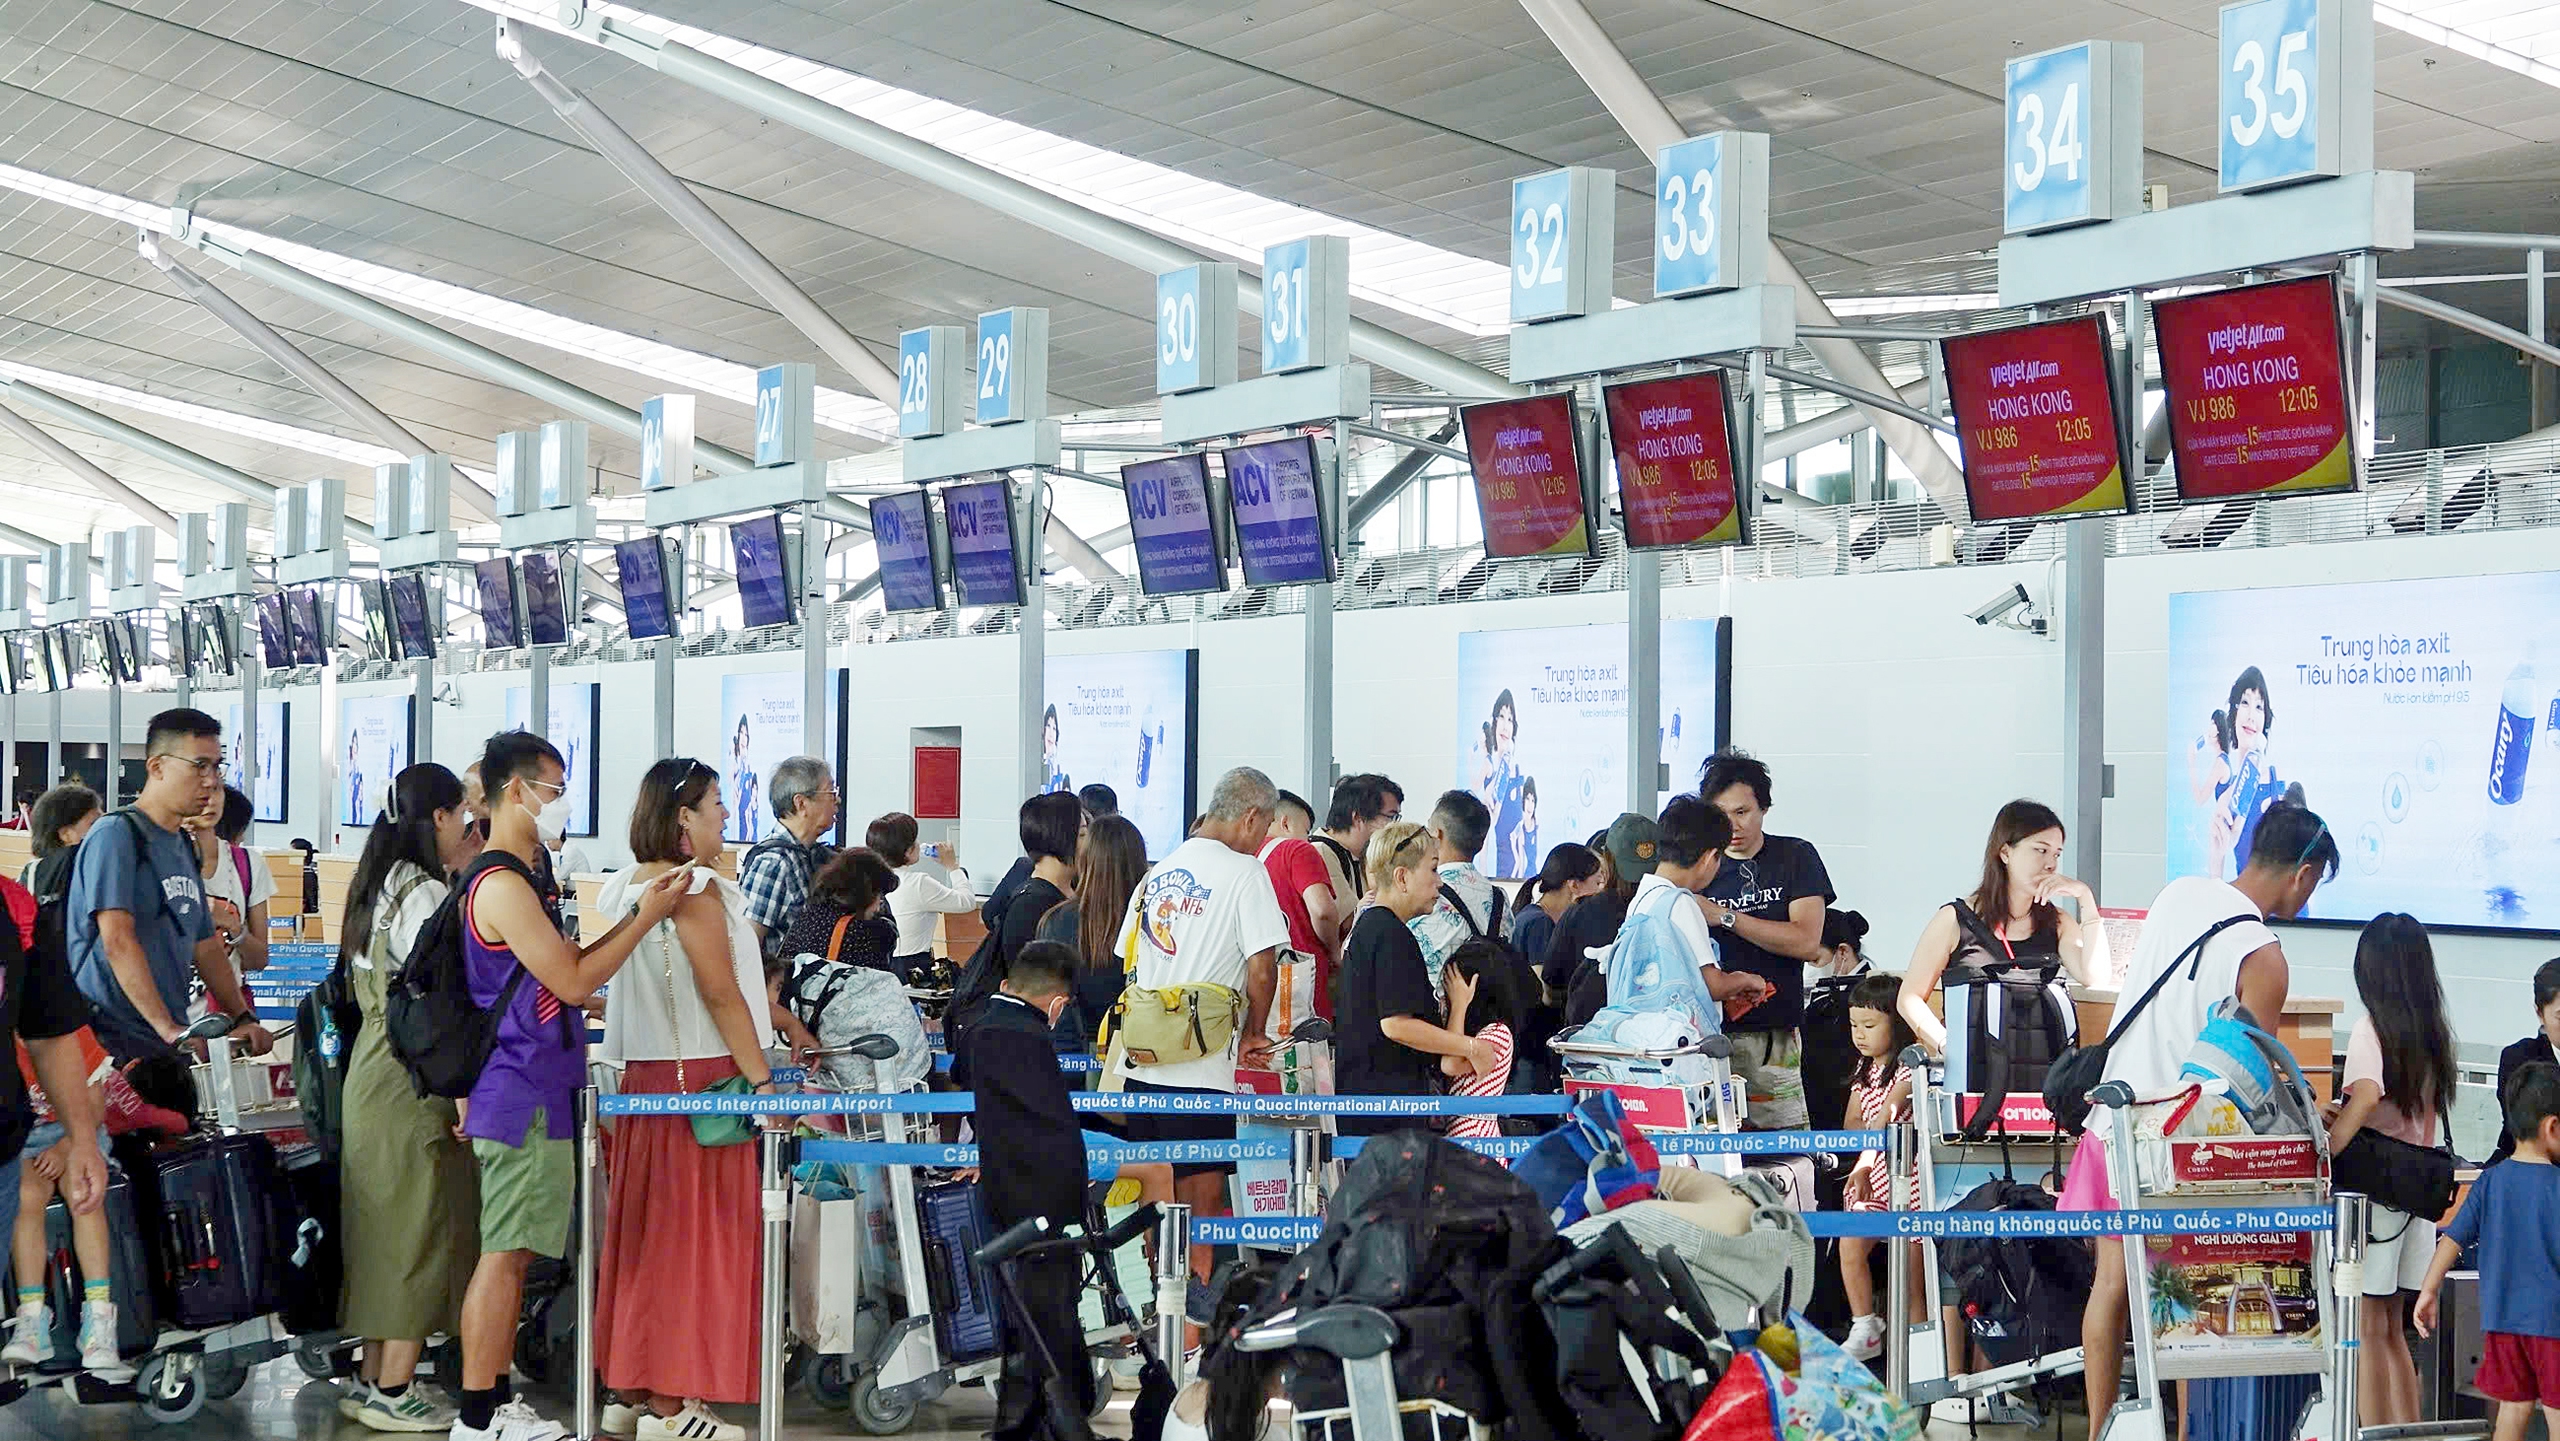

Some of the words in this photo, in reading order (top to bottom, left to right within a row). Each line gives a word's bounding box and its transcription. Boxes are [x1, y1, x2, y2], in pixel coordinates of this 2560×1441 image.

[2230, 31, 2310, 146] 35
[2014, 82, 2082, 192] 34
[1662, 168, 1717, 261] 33
[1517, 202, 1565, 289] 32
[1270, 269, 1304, 344] 31
[1161, 291, 1196, 366] 30
[981, 333, 1009, 400] 29
[2203, 364, 2249, 390] HONG
[2253, 356, 2299, 384] KONG
[902, 351, 928, 415] 28
[1988, 397, 2028, 420] HONG
[2032, 390, 2072, 416] KONG
[2187, 399, 2206, 423] VJ
[2210, 396, 2236, 421] 986
[2279, 386, 2318, 413] 12:05
[758, 386, 782, 446] 27
[1976, 430, 1992, 450] VJ
[1995, 427, 2018, 448] 986
[2056, 417, 2092, 443] 12:05
[2248, 426, 2259, 445] 15
[1638, 438, 1669, 460] HONG
[1672, 433, 1703, 456] KONG
[2237, 446, 2248, 464] 15
[1495, 457, 1523, 477] HONG
[1524, 453, 1552, 473] KONG
[1690, 459, 1718, 481] 12:05
[2029, 454, 2040, 472] 15
[1233, 463, 1271, 507] ACV
[1541, 476, 1566, 497] 12:05
[1630, 468, 1643, 486] VJ
[1643, 465, 1661, 485] 986
[2021, 472, 2032, 489] 15
[1130, 479, 1166, 520] ACV
[1487, 485, 1500, 501] VJ
[1500, 481, 1517, 499] 986
[876, 511, 900, 546] ACV
[951, 502, 977, 538] ACV
[2321, 635, 2373, 661] Trung
[2379, 633, 2411, 655] hòa
[2417, 632, 2451, 655] axit
[1545, 666, 1575, 686] Trung
[1578, 665, 1596, 682] hòa
[1599, 664, 1618, 681] axit
[2296, 664, 2332, 686] Tiêu
[2337, 662, 2368, 685] hóa
[2374, 660, 2416, 684] khỏe
[2422, 660, 2472, 688] mạnh
[1077, 685, 1096, 702] Trung
[1111, 685, 1124, 698] axit
[1531, 687, 1551, 704] Tiêu
[1554, 686, 1572, 703] hóa
[1602, 686, 1629, 706] mạnh
[1068, 702, 1081, 716] Tiêu
[1160, 871, 1192, 890] BOWL
[1180, 897, 1203, 915] NFL
[300, 946, 323, 954] Quoc
[1121, 1091, 1135, 1108] tế
[1139, 1095, 1166, 1109] Phú
[1173, 1092, 1211, 1110] Quốc
[1223, 1098, 1250, 1111] Phu
[1254, 1098, 1292, 1111] Quoc
[1295, 1099, 1386, 1112] International
[1389, 1099, 1440, 1114] Airport
[1721, 1082, 1732, 1102] 587
[629, 1097, 662, 1111] Phu
[667, 1097, 712, 1111] Quoc
[717, 1097, 827, 1112] International
[832, 1096, 893, 1113] Airport
[944, 1144, 980, 1162] Cản
[1114, 1142, 1159, 1163] quốc
[1166, 1141, 1182, 1157] tế
[1189, 1143, 1222, 1157] Phú
[1229, 1141, 1275, 1157] Quốc
[1663, 1136, 1678, 1152] tế
[1684, 1138, 1714, 1152] Phú
[1721, 1135, 1756, 1151] Quốc
[1778, 1136, 1809, 1150] Phu
[1815, 1135, 1857, 1150] Quoc
[1254, 1196, 1286, 1213] 여기어때
[1200, 1223, 1236, 1239] Phu
[1241, 1222, 1291, 1241] Quoc
[1897, 1215, 1945, 1235] Cảng
[1950, 1216, 1995, 1235] hàng
[2106, 1211, 2122, 1229] tế
[2128, 1213, 2162, 1230] Phú
[2174, 1209, 2220, 1230] Quốc
[2237, 1212, 2270, 1228] Phu
[2275, 1211, 2319, 1227] Quoc
